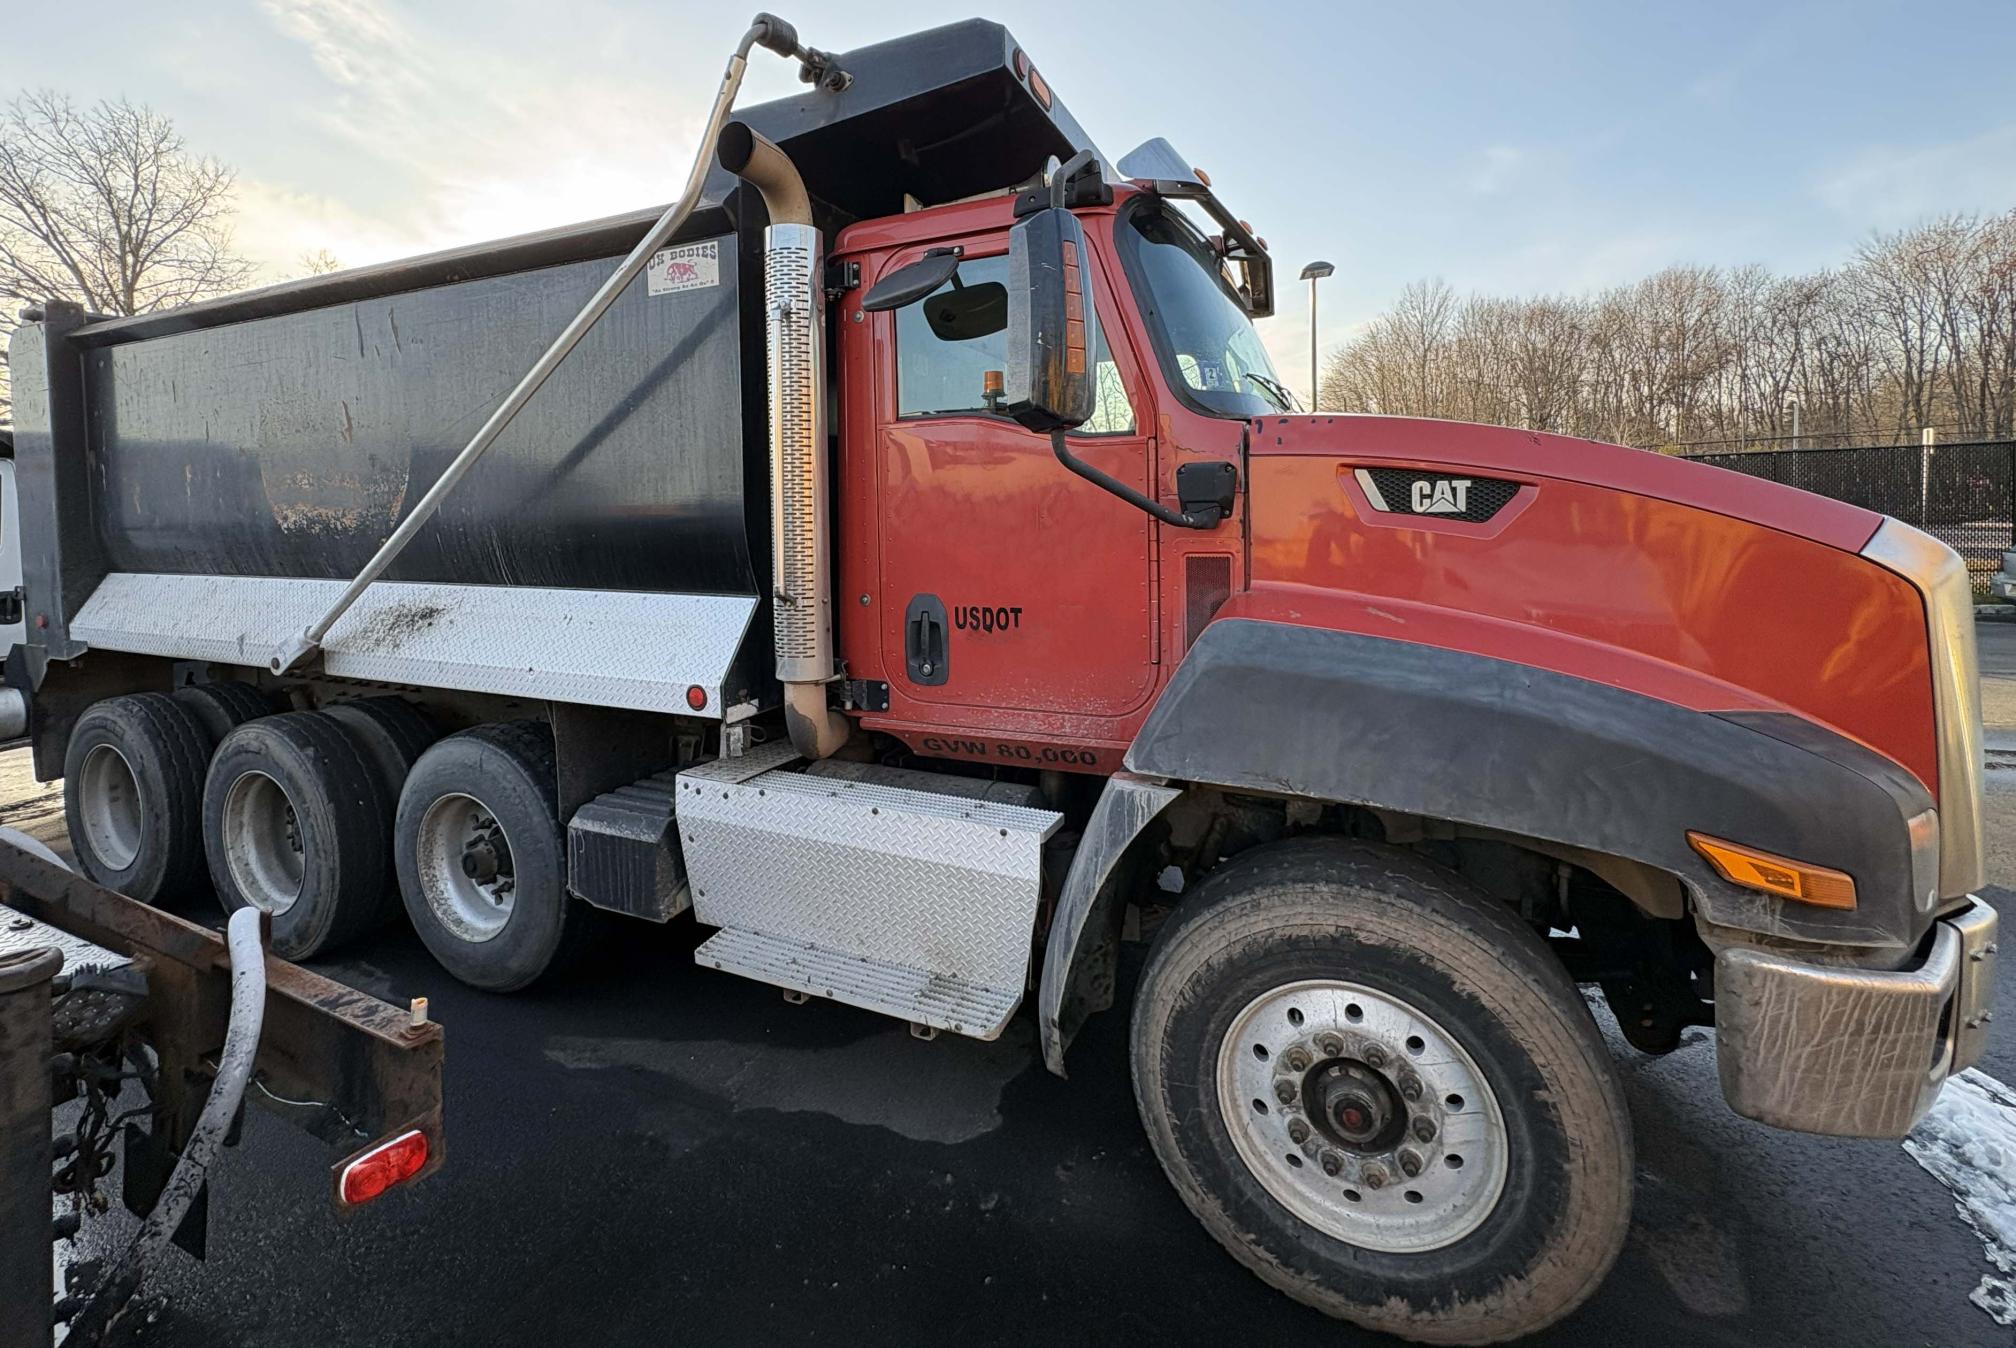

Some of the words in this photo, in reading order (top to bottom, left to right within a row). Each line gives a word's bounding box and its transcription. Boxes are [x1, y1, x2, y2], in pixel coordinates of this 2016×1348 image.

[670, 244, 717, 260] BODIES
[1208, 368, 1215, 380] 2
[1411, 480, 1472, 513] CAT
[954, 606, 1023, 633] USDOT
[922, 737, 987, 756] GVW
[996, 744, 1098, 766] 80,000
